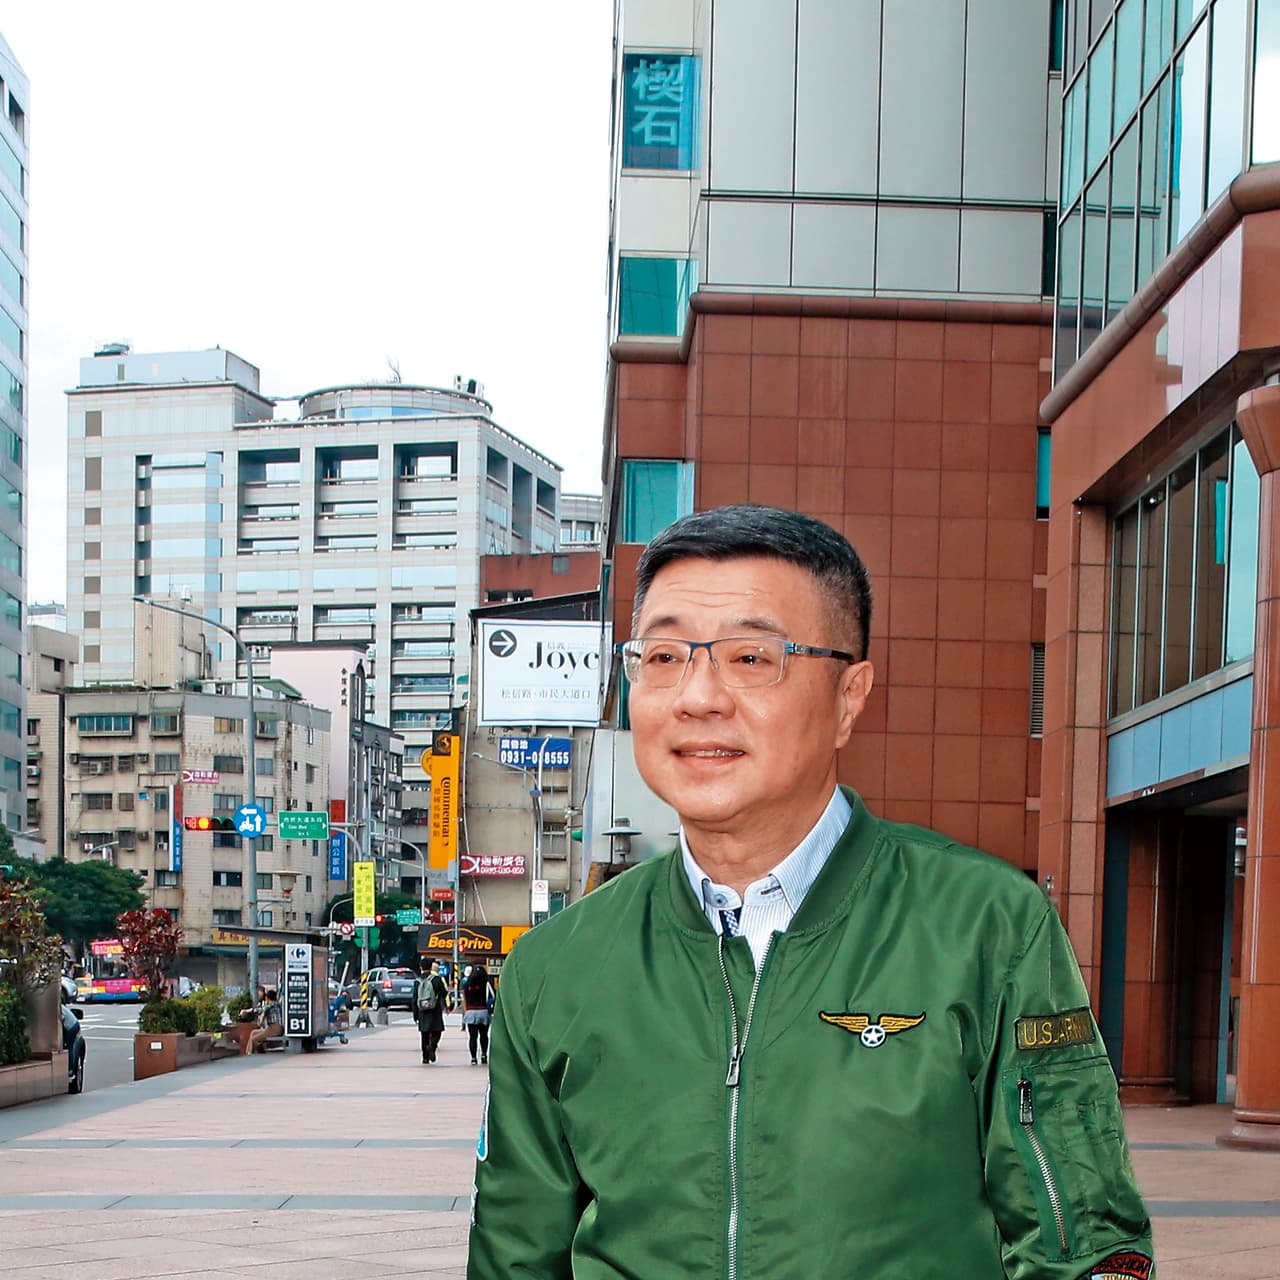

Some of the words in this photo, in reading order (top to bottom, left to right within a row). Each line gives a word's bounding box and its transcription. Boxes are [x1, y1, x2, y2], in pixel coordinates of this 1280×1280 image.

[631, 58, 684, 146] 楔石
[500, 750, 569, 765] 0931-08555
[440, 776, 451, 838] Continental
[428, 935, 493, 950] BesDrive
[290, 1018, 306, 1031] B1
